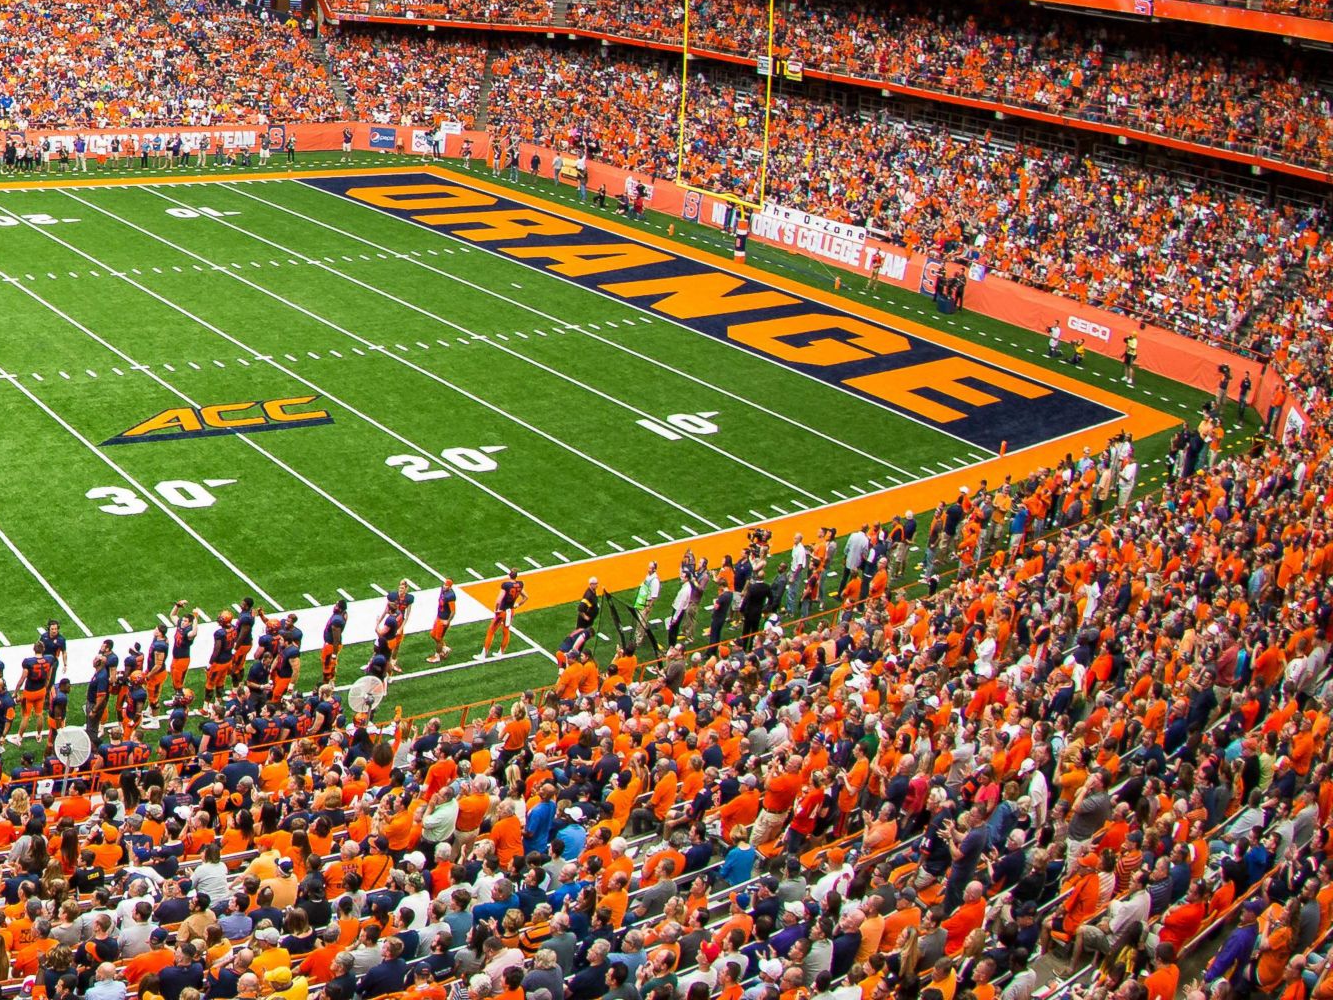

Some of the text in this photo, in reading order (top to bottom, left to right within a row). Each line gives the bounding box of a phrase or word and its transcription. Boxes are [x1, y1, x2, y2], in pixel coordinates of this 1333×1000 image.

[379, 134, 395, 142] pepsi
[763, 203, 866, 241] The O-Zone
[751, 214, 861, 267] ORK'S COLLEGE
[344, 184, 1056, 423] ORANGE
[1067, 316, 1111, 341] GEICO
[121, 395, 331, 436] ACC
[634, 412, 720, 441] 10
[385, 447, 500, 483] 20
[84, 479, 220, 518] 30
[215, 728, 233, 746] 60
[263, 728, 280, 742] 79
